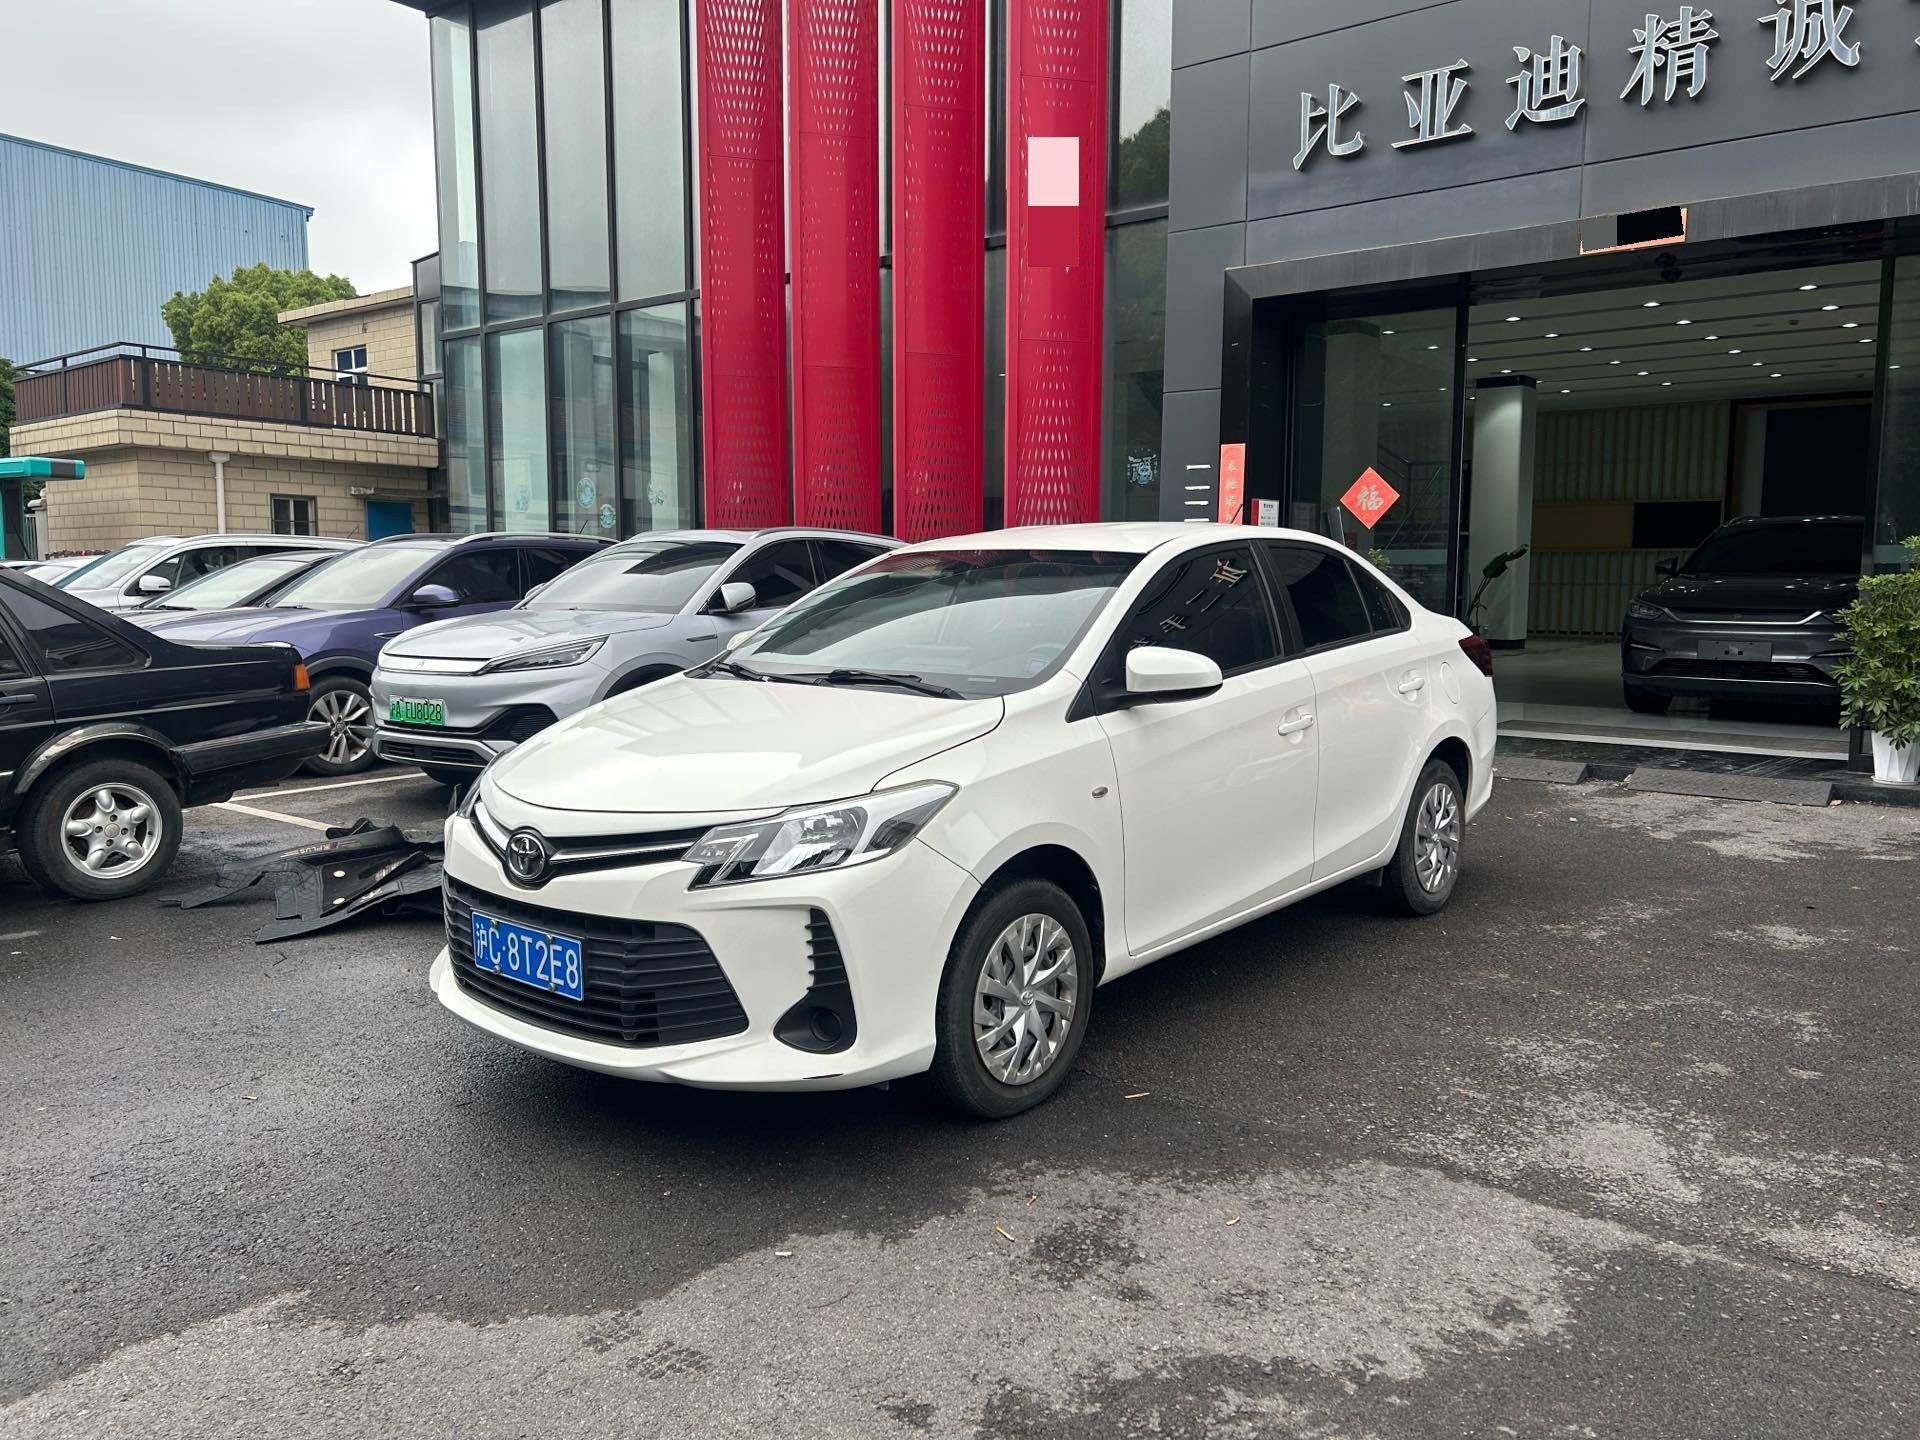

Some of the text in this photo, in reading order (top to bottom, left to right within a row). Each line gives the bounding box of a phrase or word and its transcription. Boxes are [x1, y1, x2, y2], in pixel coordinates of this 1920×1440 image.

[1293, 0, 1920, 170] 比亚迪精诚
[1356, 484, 1384, 511] 福
